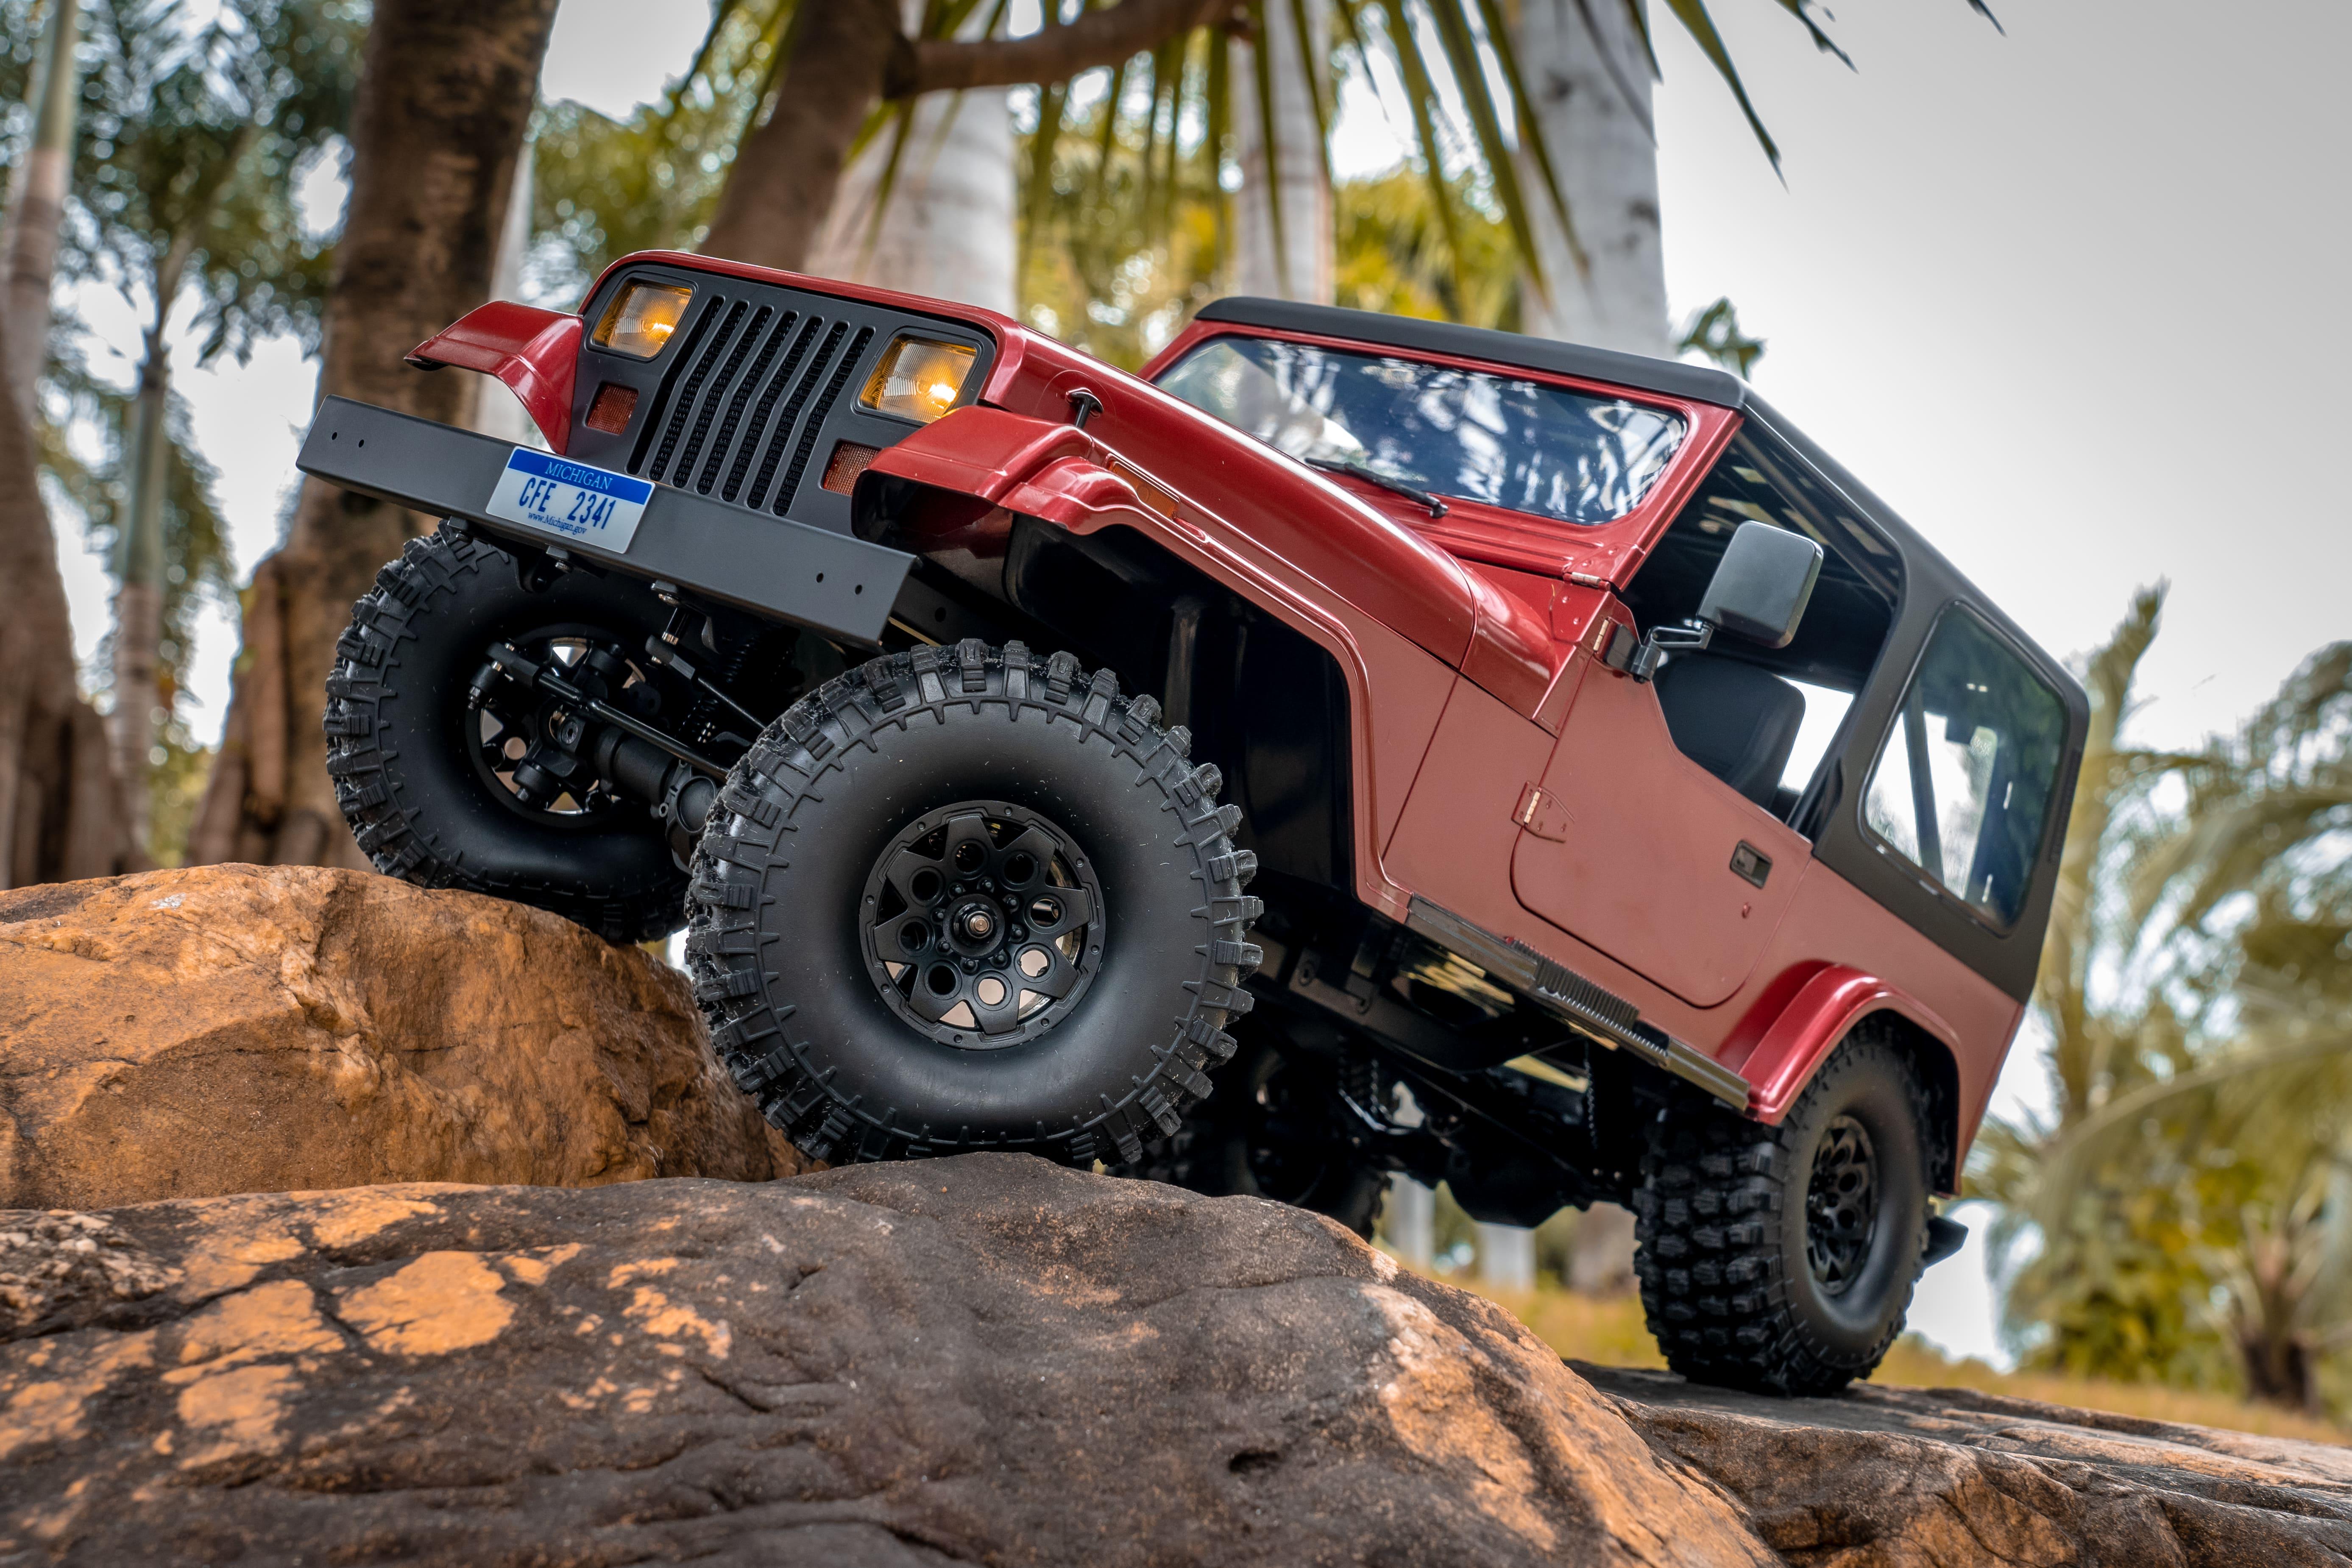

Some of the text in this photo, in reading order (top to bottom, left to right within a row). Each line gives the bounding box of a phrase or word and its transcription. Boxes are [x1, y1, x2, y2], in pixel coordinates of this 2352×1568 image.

[545, 462, 613, 490] MICHIGAN
[519, 477, 616, 529] CFE 2341
[528, 512, 587, 535] www.Michigan.gov
